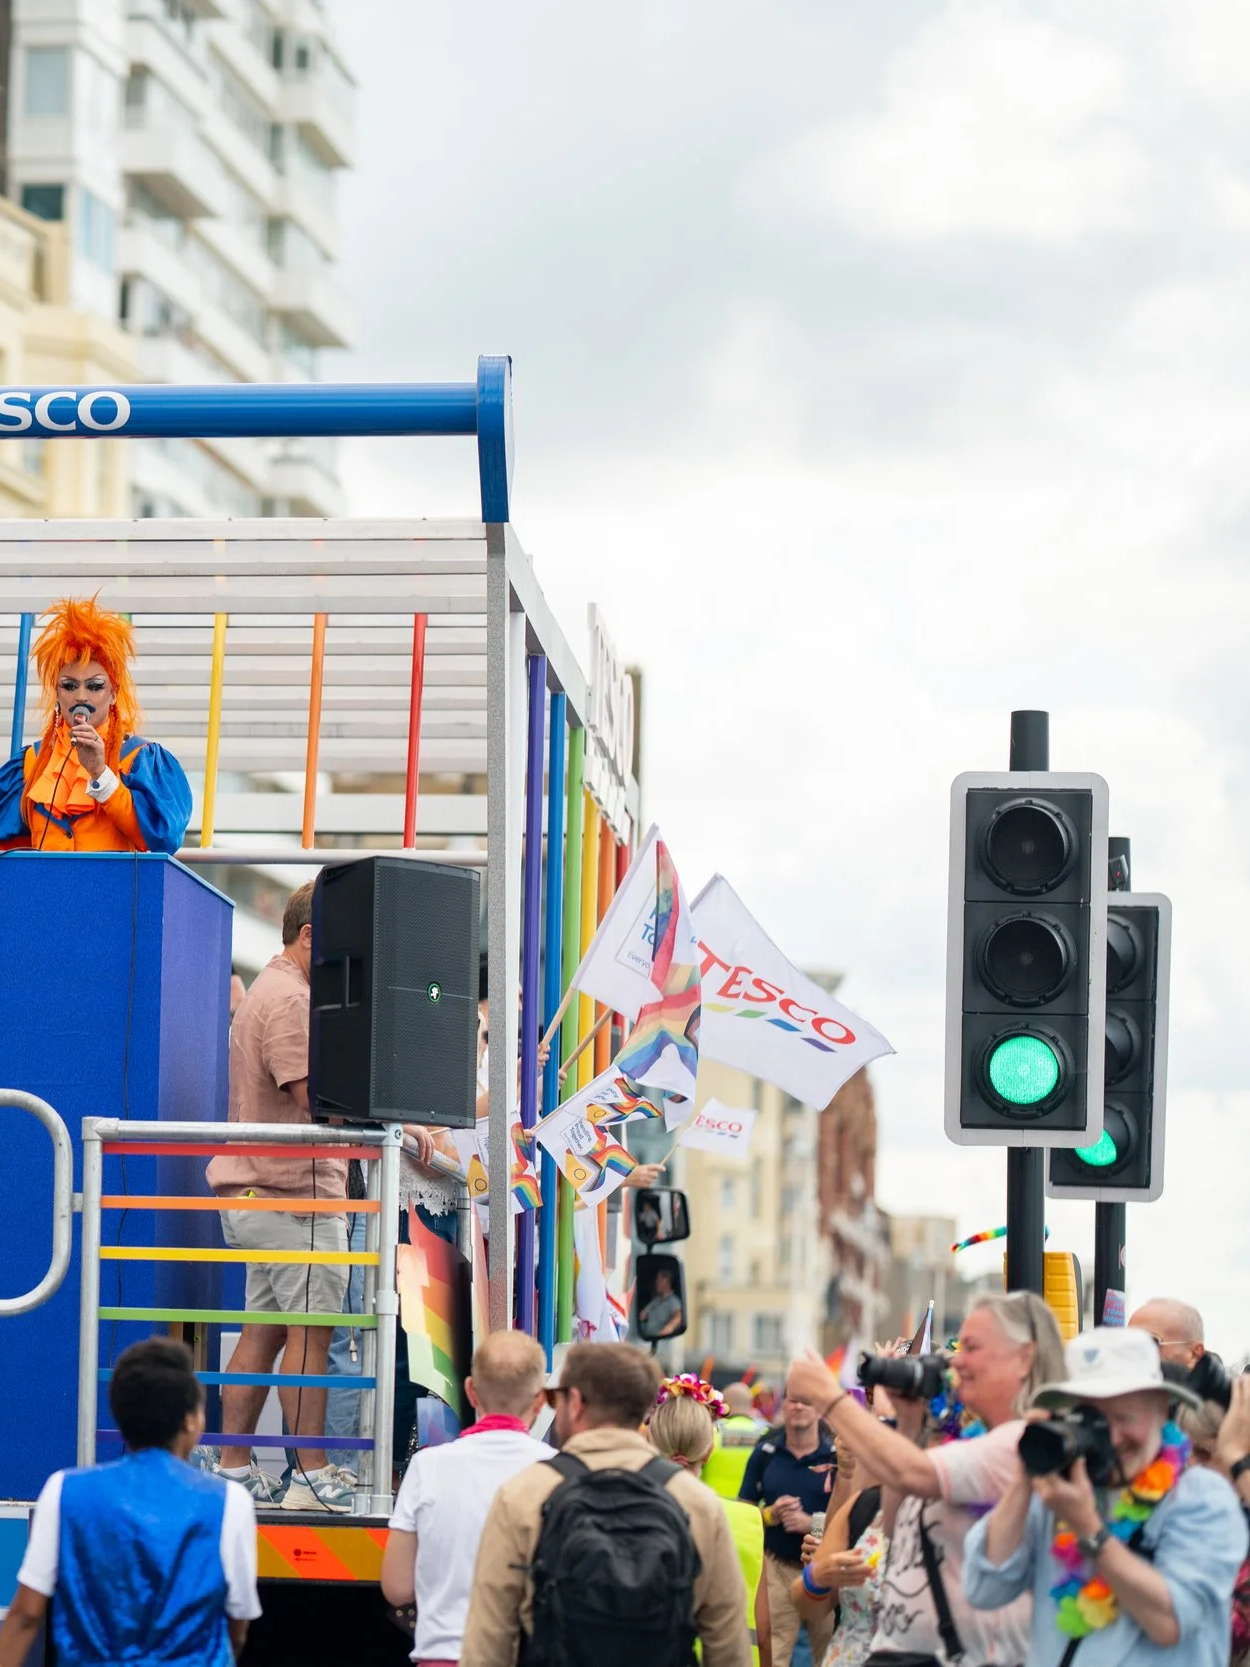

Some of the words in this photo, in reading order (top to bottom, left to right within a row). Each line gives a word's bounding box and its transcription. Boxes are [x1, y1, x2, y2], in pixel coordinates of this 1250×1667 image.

[627, 950, 651, 970] Everyo
[697, 939, 857, 1045] TESCO
[695, 1114, 743, 1133] ESCO
